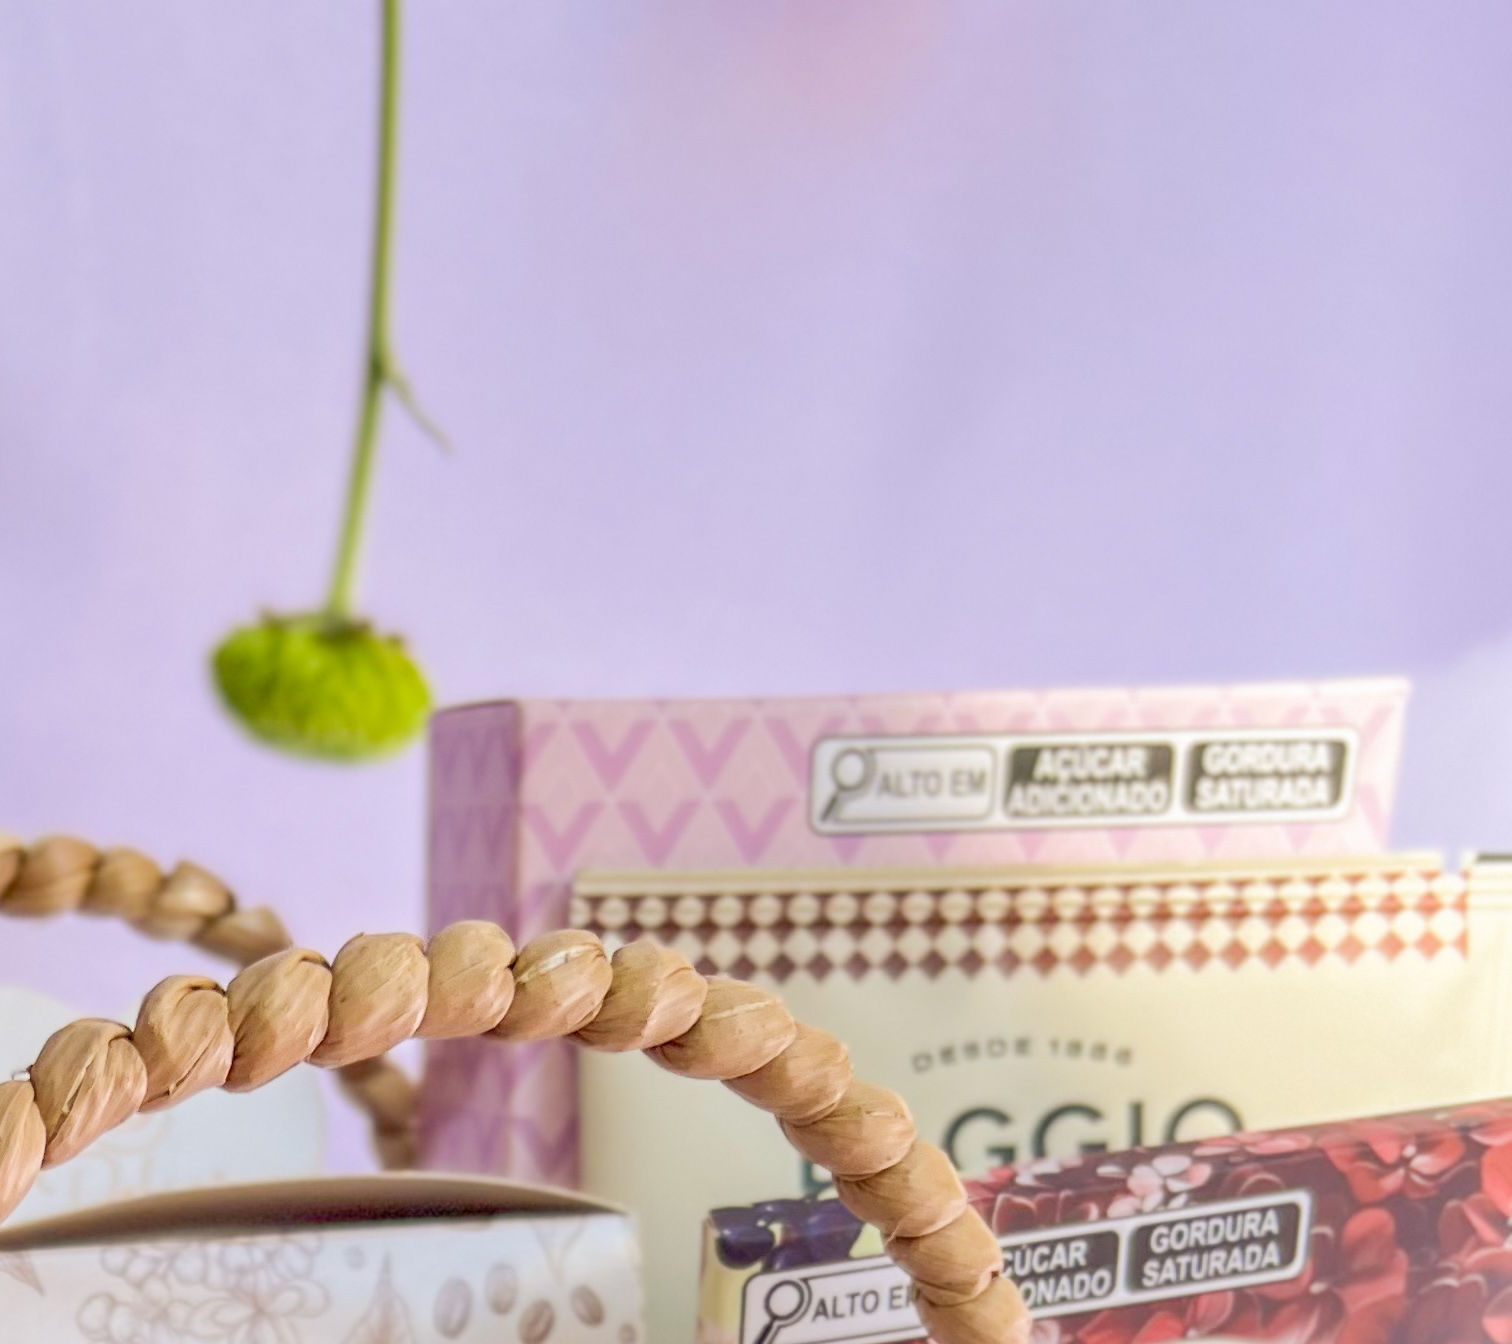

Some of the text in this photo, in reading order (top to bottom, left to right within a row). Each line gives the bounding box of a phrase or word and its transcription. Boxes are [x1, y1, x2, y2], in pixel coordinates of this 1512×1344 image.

[1202, 742, 1331, 776] GORDURA
[876, 767, 987, 800] ALTO EM
[1007, 780, 1168, 817] ADICIONADO
[1195, 775, 1330, 809] SATURADA
[913, 1037, 1033, 1074] DESDE
[1149, 1207, 1279, 1255] GORDURA
[1141, 1246, 1280, 1289] SATURADA
[811, 1289, 880, 1323] ALTO
